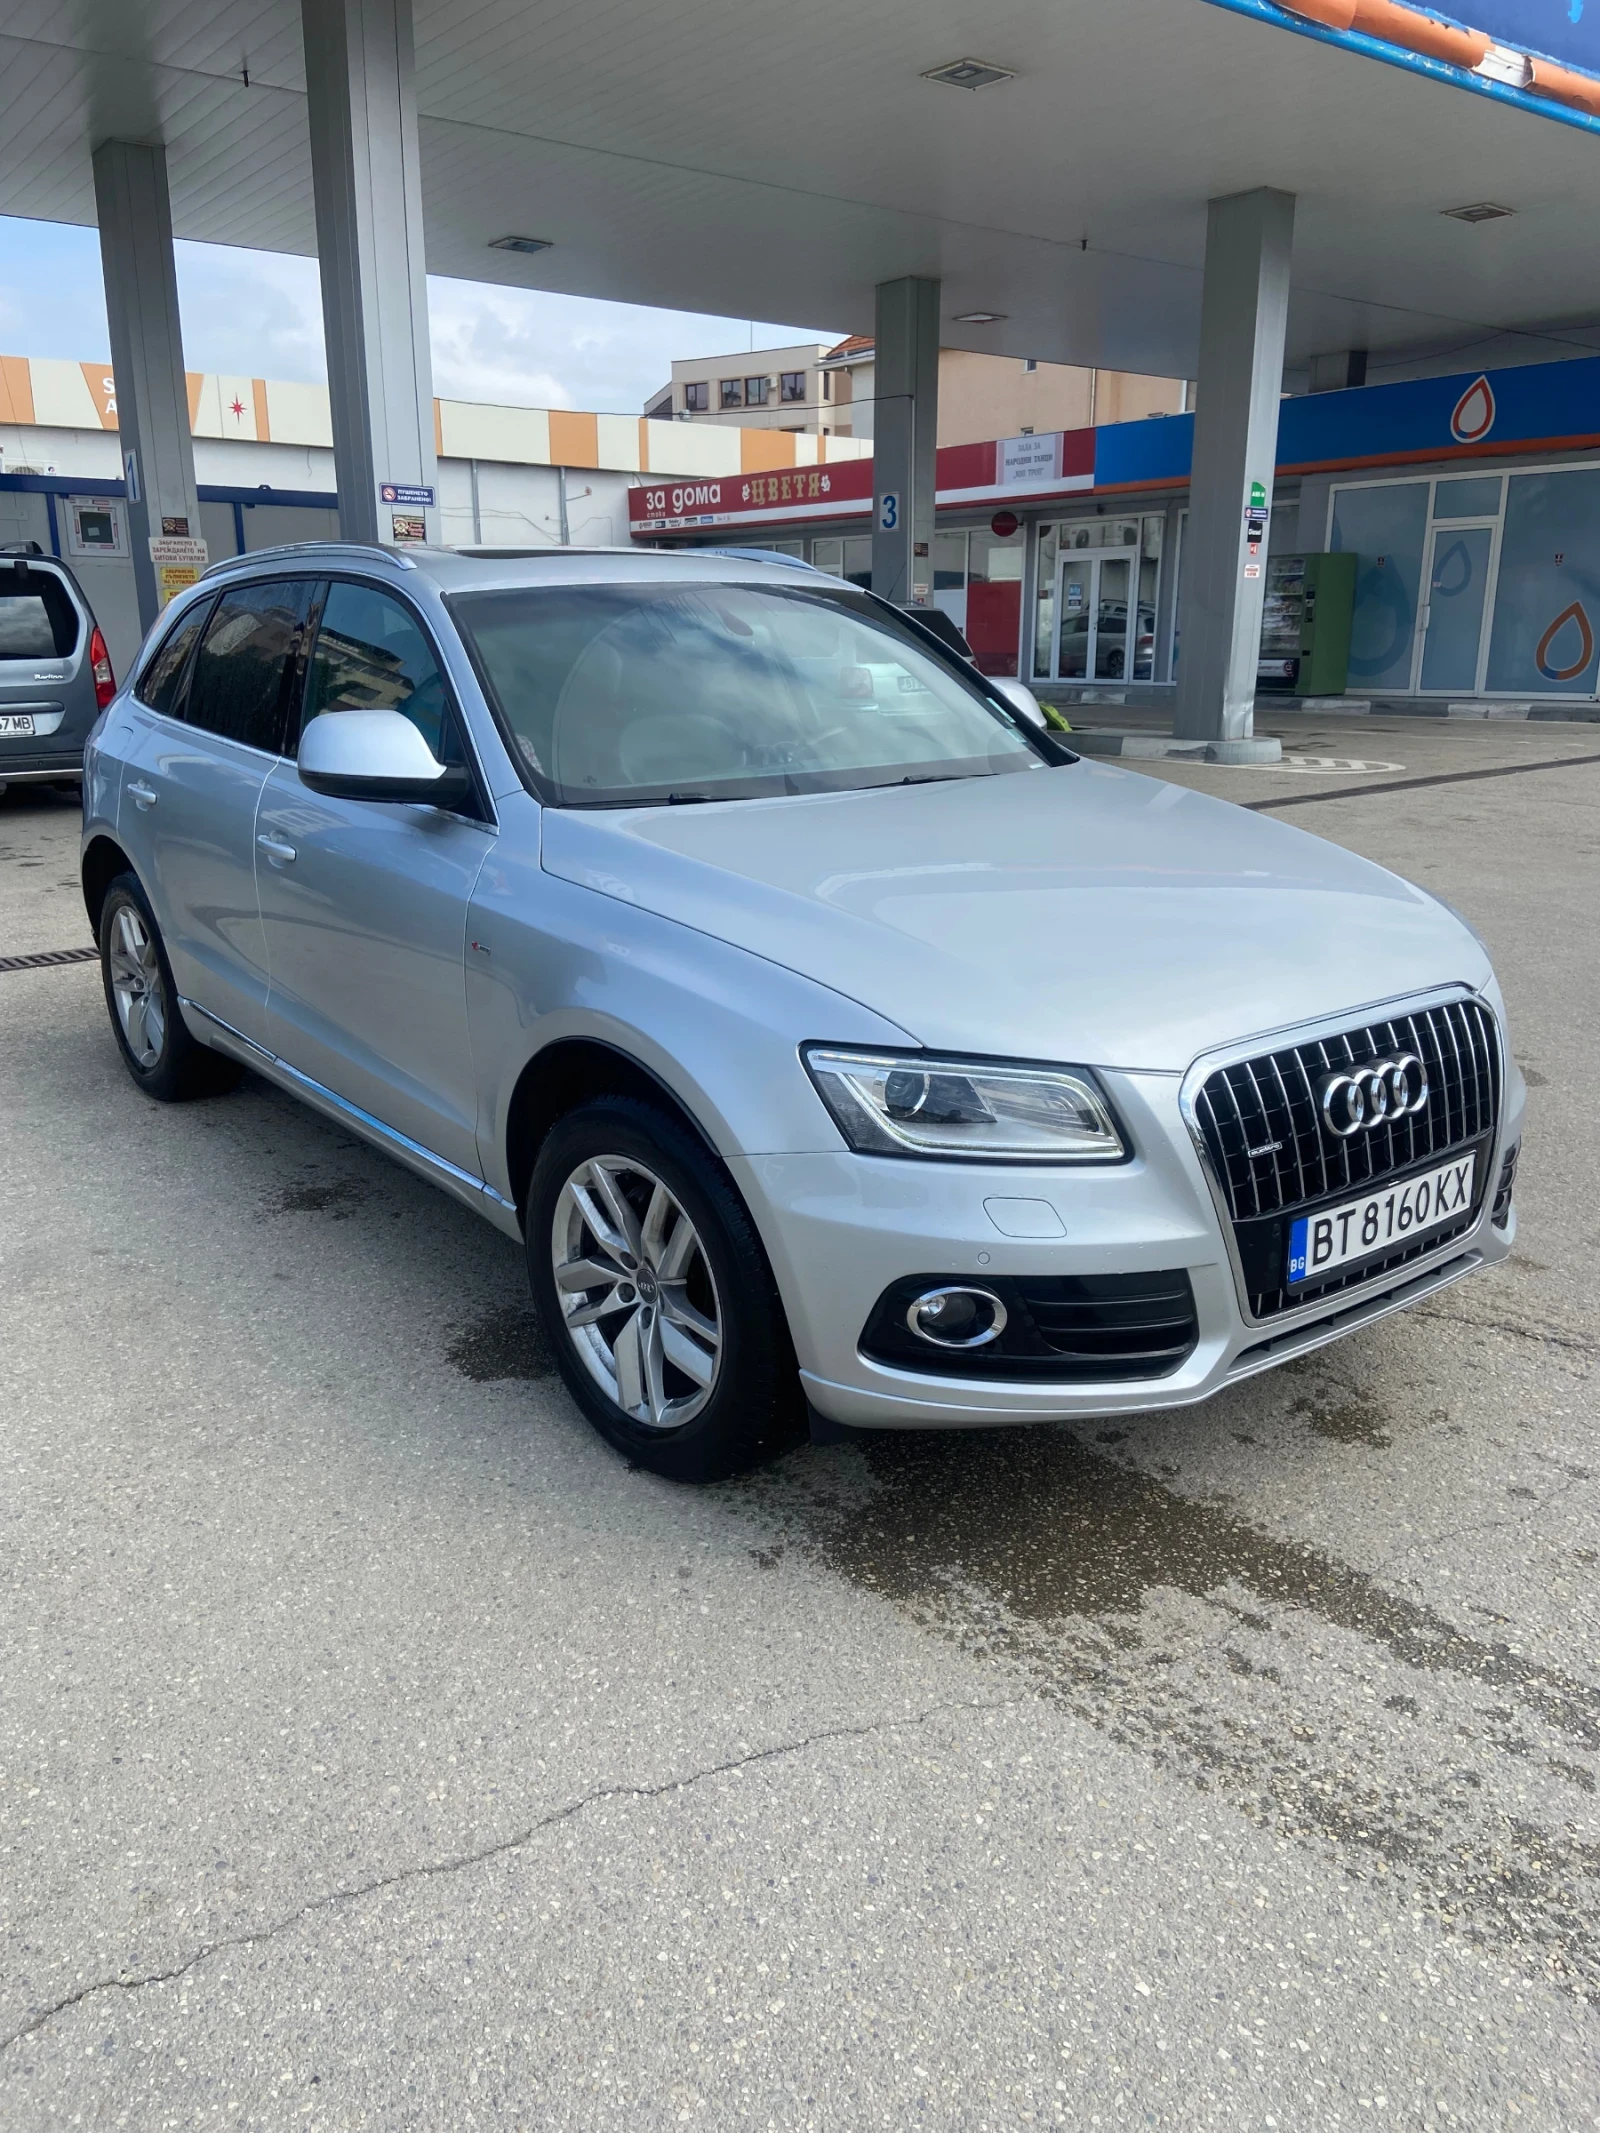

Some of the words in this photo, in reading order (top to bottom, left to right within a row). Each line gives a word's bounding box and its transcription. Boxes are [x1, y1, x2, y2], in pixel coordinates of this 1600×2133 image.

[127, 454, 137, 500] 1
[1005, 456, 1032, 467] НАРОДНИ
[751, 472, 820, 506] ЦВЕТЯ
[882, 495, 897, 529] 3
[1312, 1208, 1356, 1266] BT
[1361, 1180, 1430, 1246] 8160
[1434, 1162, 1470, 1217] KX
[1290, 1256, 1305, 1273] BG
